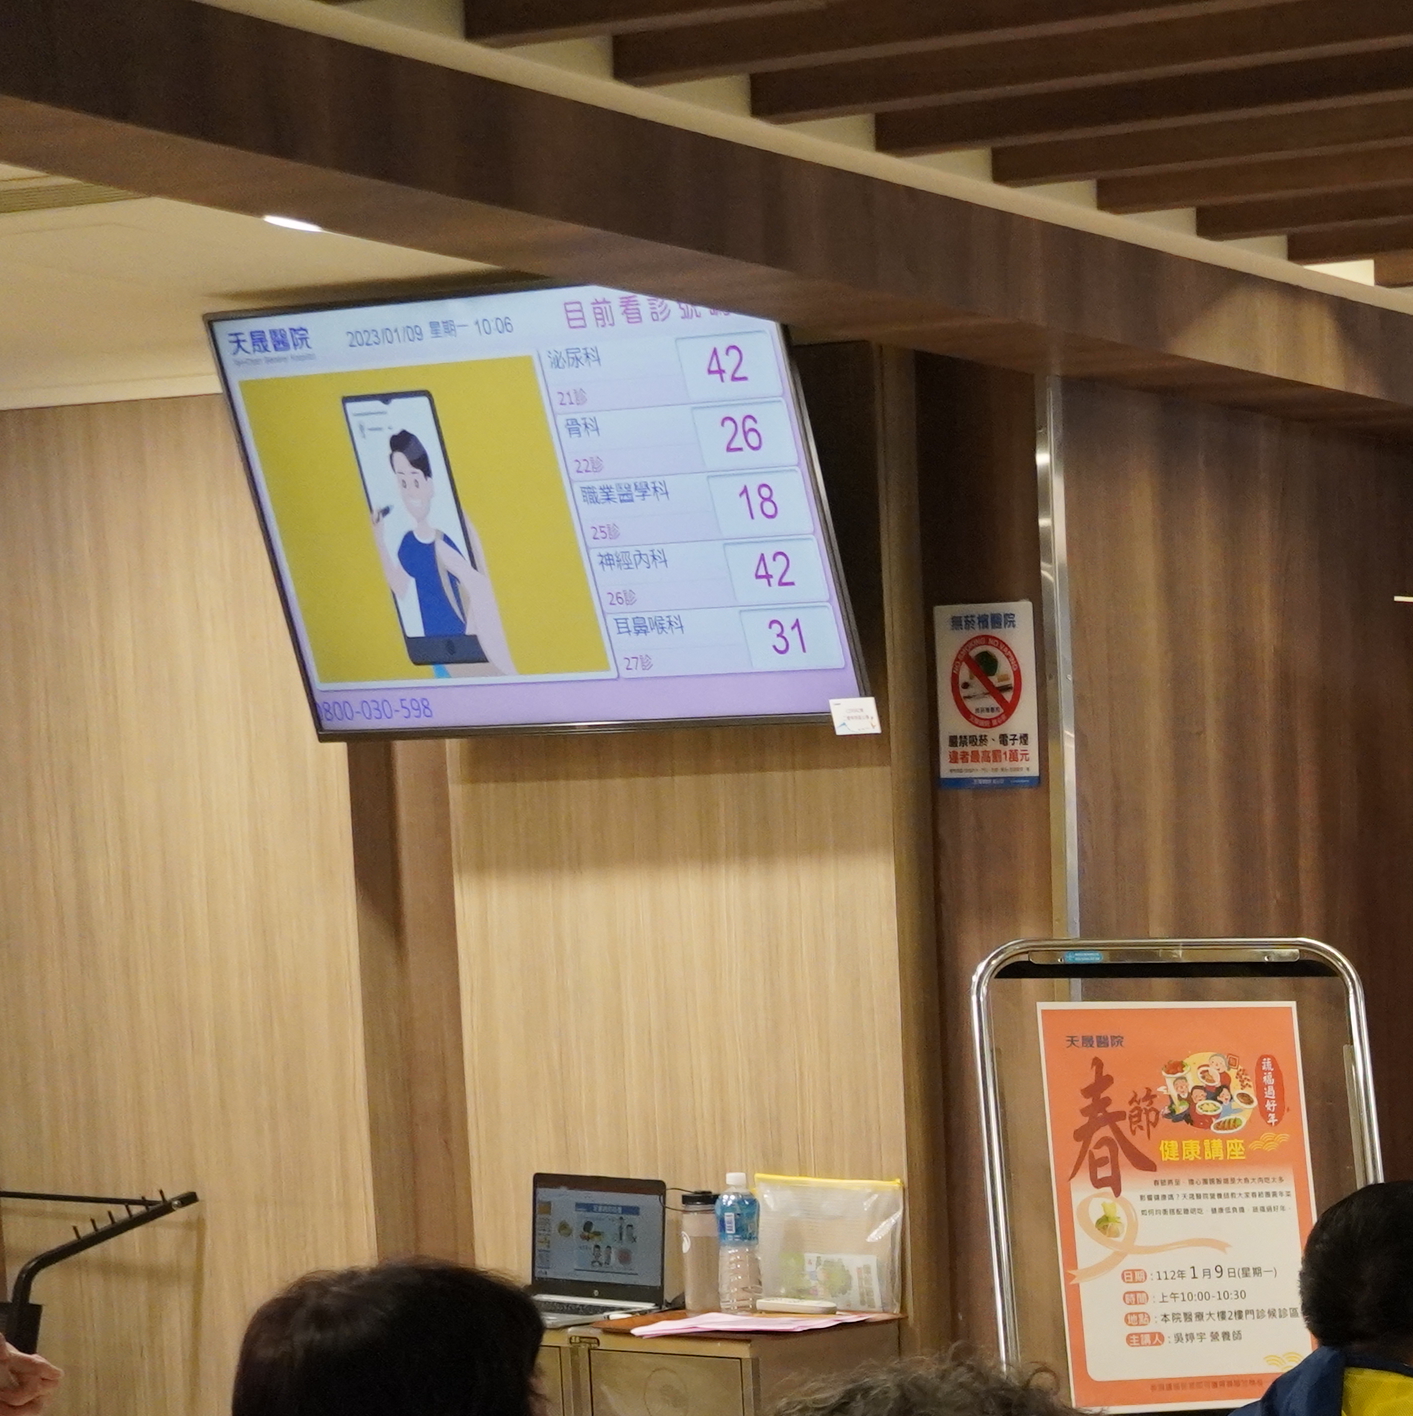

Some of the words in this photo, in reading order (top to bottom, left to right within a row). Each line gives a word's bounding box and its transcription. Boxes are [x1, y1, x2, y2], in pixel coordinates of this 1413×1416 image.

[227, 327, 313, 357] 天晟醫院
[346, 325, 424, 348] 2023/01/09
[429, 319, 469, 339] 星期一
[474, 316, 514, 336] 10:06
[548, 346, 602, 370] 泌尿科
[707, 345, 748, 383] 42
[556, 388, 588, 406] 21診
[564, 416, 600, 438] 骨科
[721, 414, 762, 452] 26
[574, 456, 604, 474] 22診
[580, 480, 670, 505] 職業醫學科
[739, 483, 778, 520] 18
[590, 523, 620, 541] 25診
[598, 548, 669, 571] 神經內科
[754, 551, 795, 588] 42
[606, 589, 637, 606] 26診
[613, 614, 685, 636] 耳鼻喉科
[768, 618, 807, 655] 31
[623, 654, 654, 671] 27診
[1066, 1035, 1125, 1049] 天晟醫院
[1261, 1057, 1279, 1126] 蔬福過好年
[1070, 1056, 1161, 1197] 春節
[1159, 1139, 1247, 1161] 健康講座
[1123, 1271, 1146, 1283] 日期
[1125, 1292, 1149, 1305] 時間
[1128, 1333, 1163, 1347] 主講人
